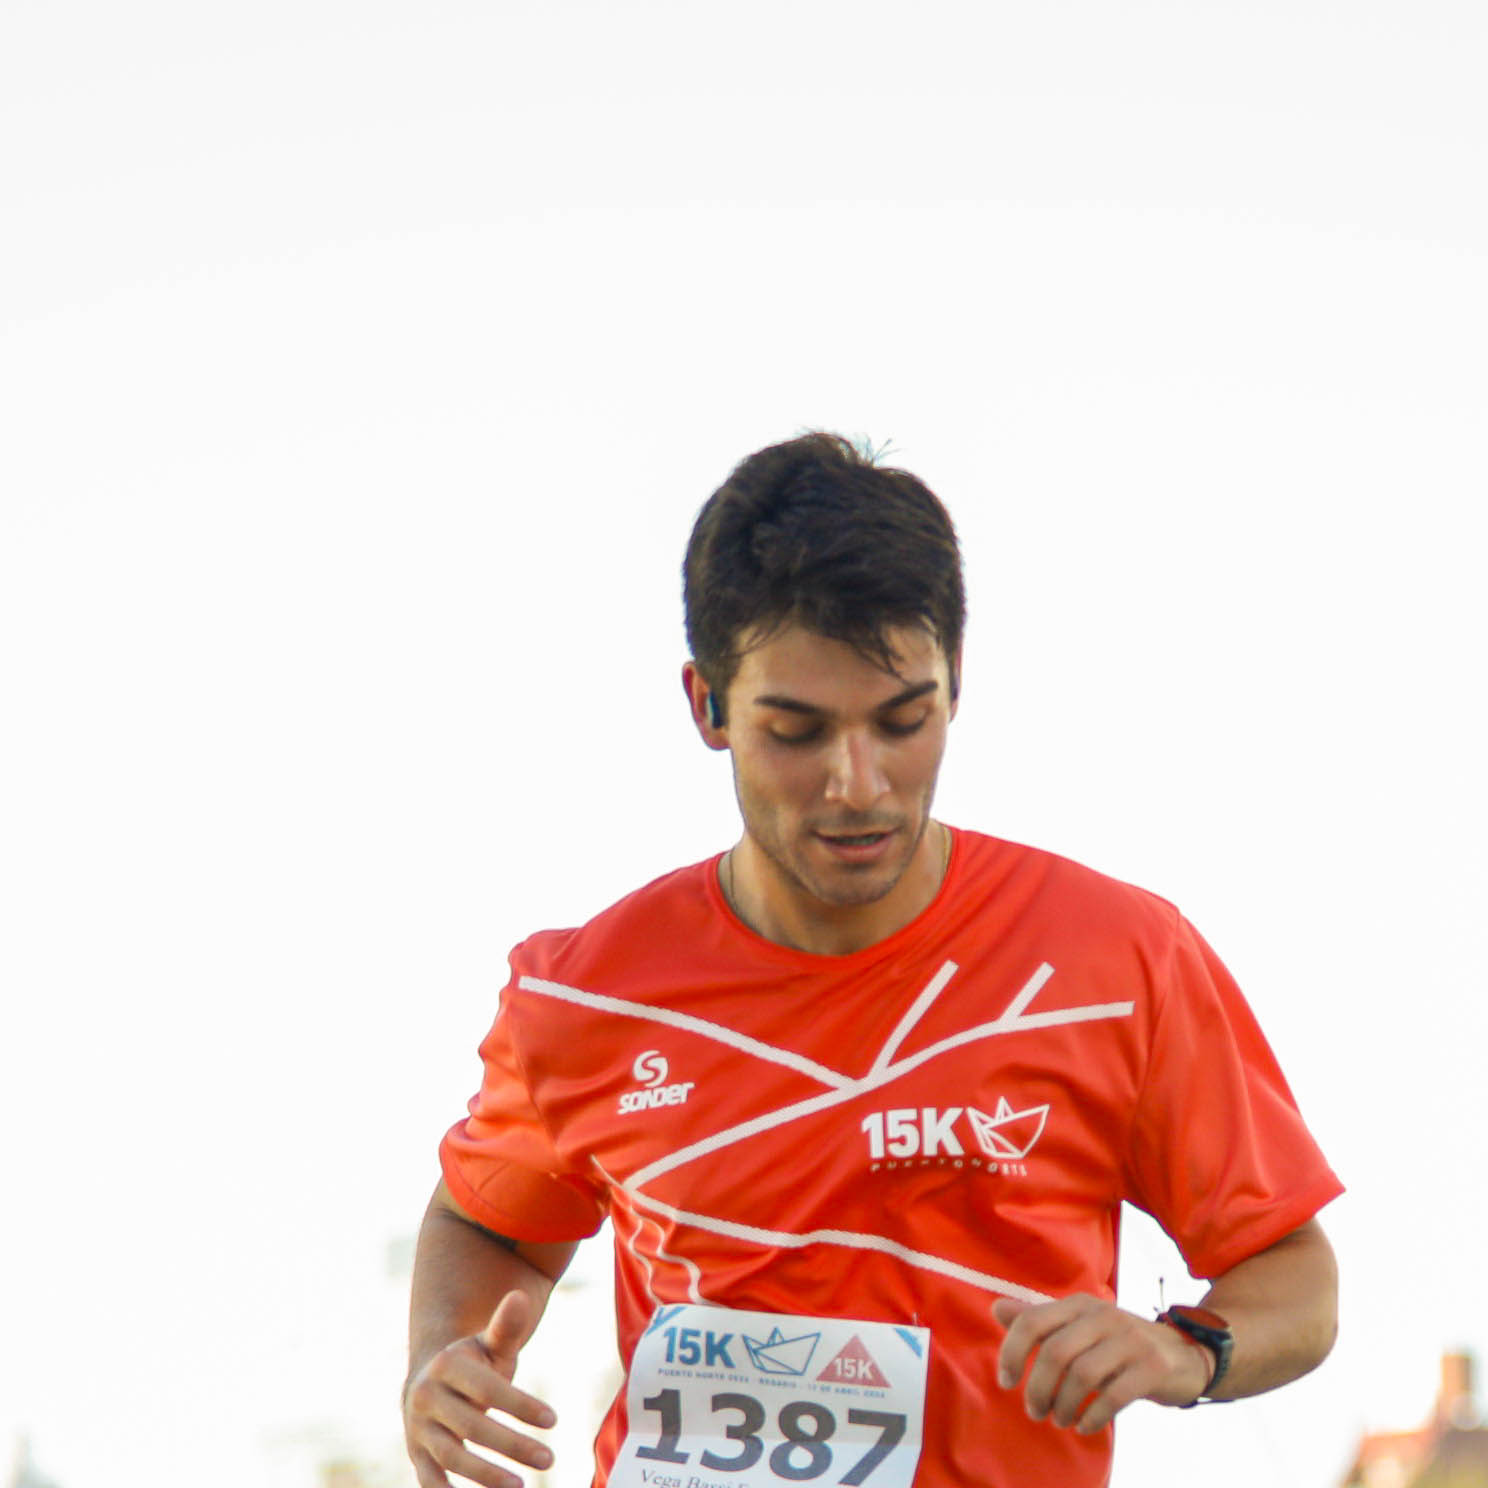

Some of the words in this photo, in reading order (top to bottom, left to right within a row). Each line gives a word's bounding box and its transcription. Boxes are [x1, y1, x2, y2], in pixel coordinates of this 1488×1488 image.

[861, 1107, 965, 1159] 15K
[663, 1325, 737, 1369] 15K
[835, 1358, 873, 1380] 15K
[635, 1388, 907, 1487] 1387
